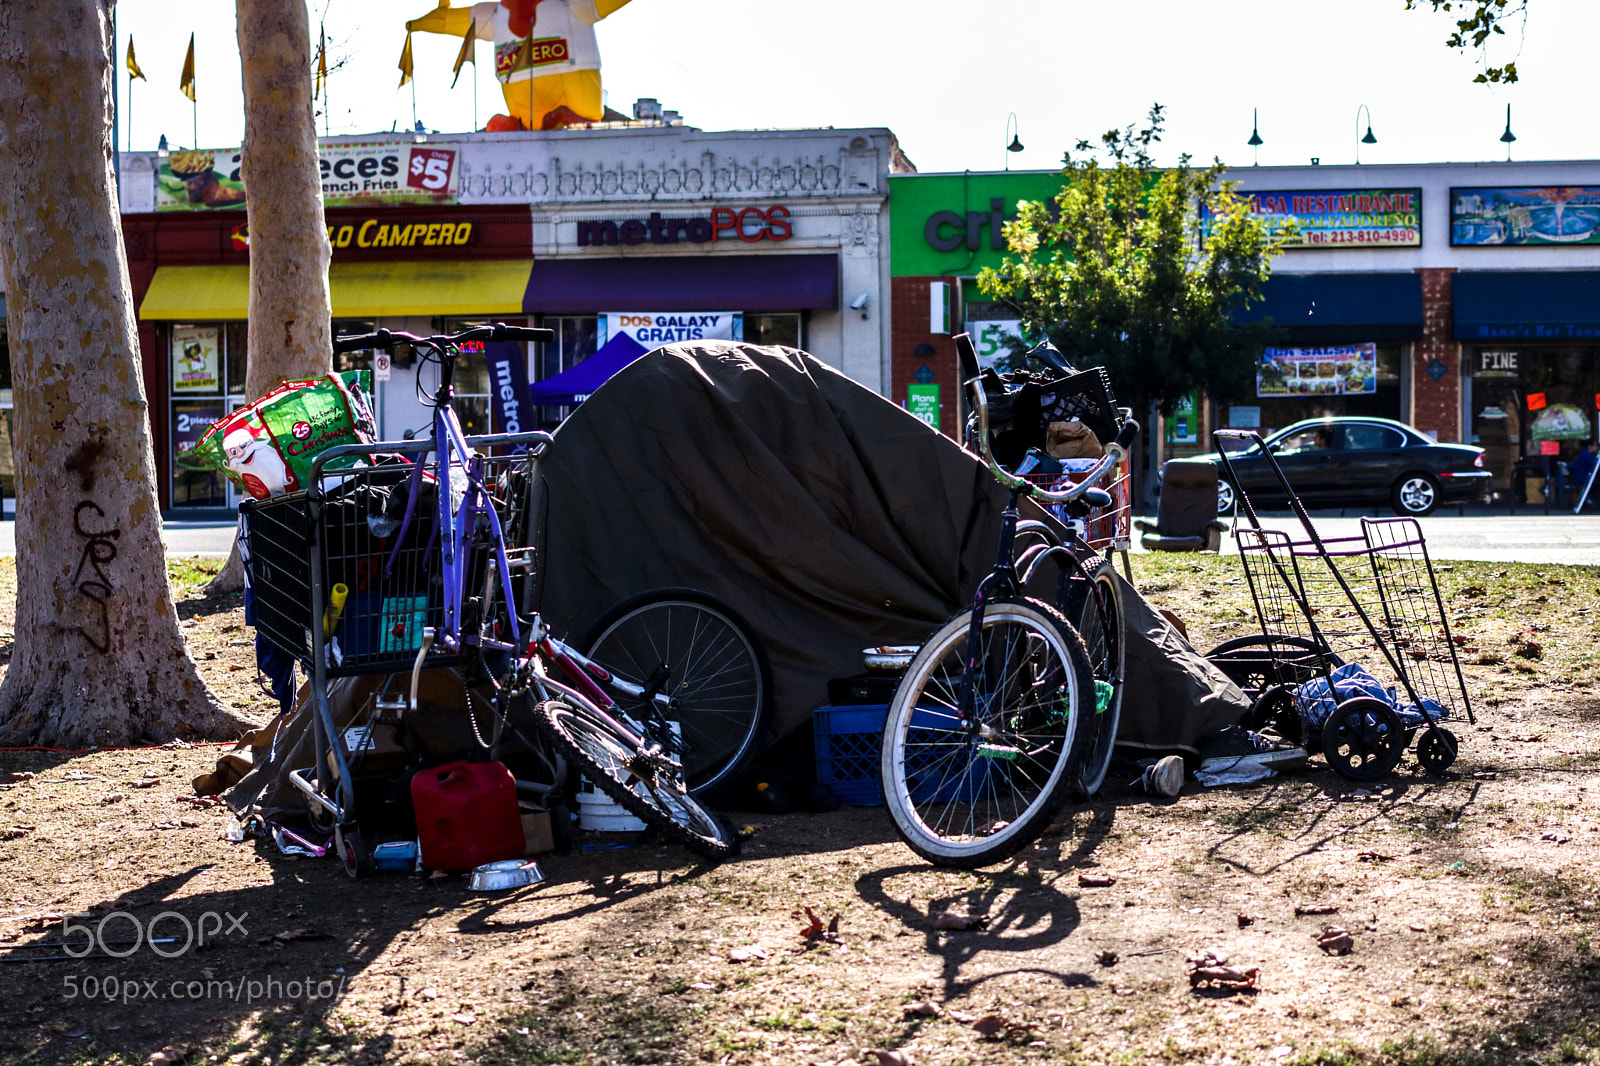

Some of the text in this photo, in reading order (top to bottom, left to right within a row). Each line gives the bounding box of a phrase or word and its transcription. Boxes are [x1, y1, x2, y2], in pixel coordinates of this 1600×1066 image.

[497, 43, 565, 69] CAERO
[410, 155, 449, 190] $5
[363, 179, 399, 191] Fries
[1292, 194, 1415, 213] RESTAURANTE
[1306, 231, 1327, 244] Tel:
[1330, 229, 1415, 243] 213-810-4990
[620, 315, 720, 327] DOS GALAXY
[636, 327, 704, 342] GRATIS
[1481, 352, 1518, 369] FINE
[496, 360, 520, 434] metro
[912, 394, 935, 402] Plans
[178, 414, 190, 432] 2
[293, 423, 310, 438] 25
[287, 427, 350, 456] Christmas
